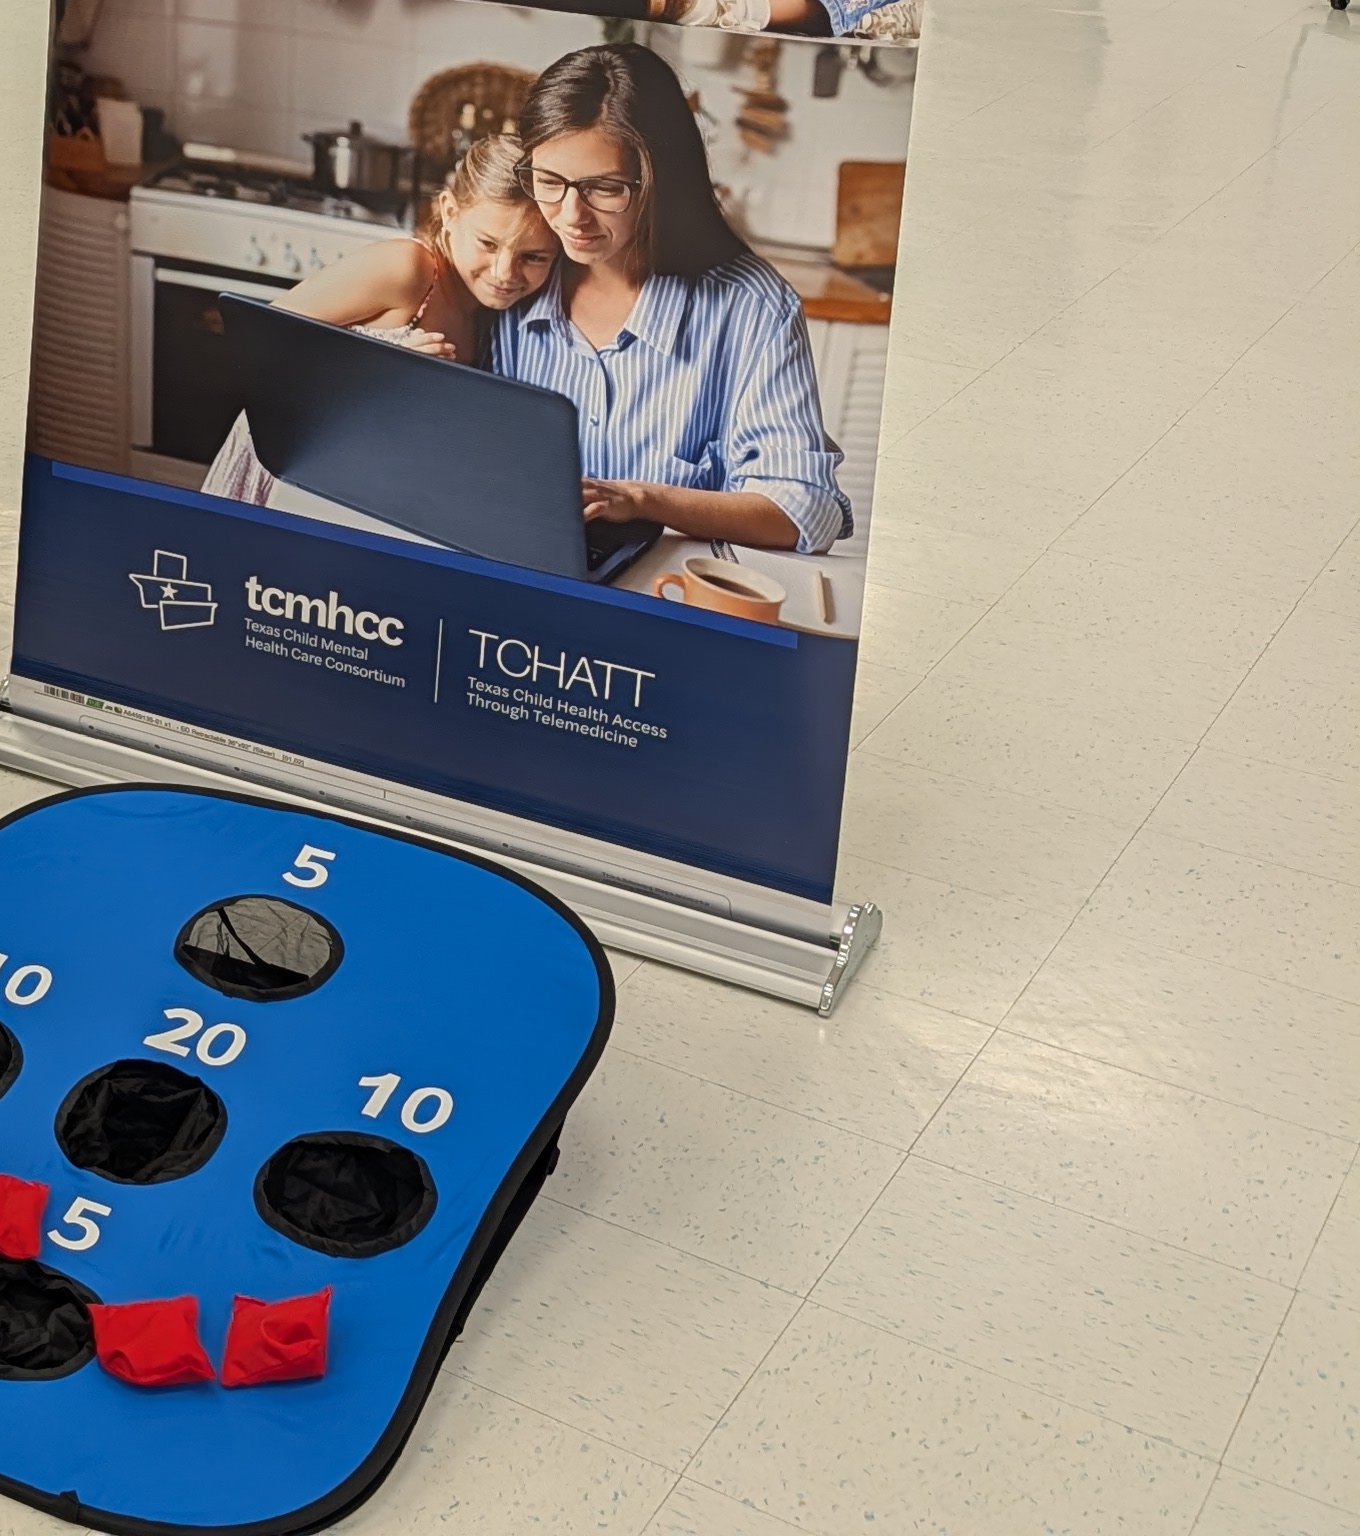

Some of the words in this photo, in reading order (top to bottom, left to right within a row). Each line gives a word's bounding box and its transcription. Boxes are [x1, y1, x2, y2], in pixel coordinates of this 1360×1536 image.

[245, 576, 404, 646] tcmhcc
[245, 618, 280, 637] Texas
[284, 629, 317, 647] Child
[322, 638, 368, 660] Mental
[246, 635, 288, 657] Health
[292, 648, 322, 665] Care
[325, 657, 405, 687] Consortium
[469, 629, 655, 707] TCHATT
[467, 692, 528, 720] Through
[533, 710, 637, 747] Telemedicine
[468, 677, 509, 697] Texas
[513, 689, 553, 709] Child
[558, 700, 608, 723] Health
[612, 714, 667, 738] Access
[282, 844, 335, 889] 5
[142, 1007, 247, 1067] 20
[357, 1071, 454, 1134] 10
[48, 1197, 113, 1251] 5
